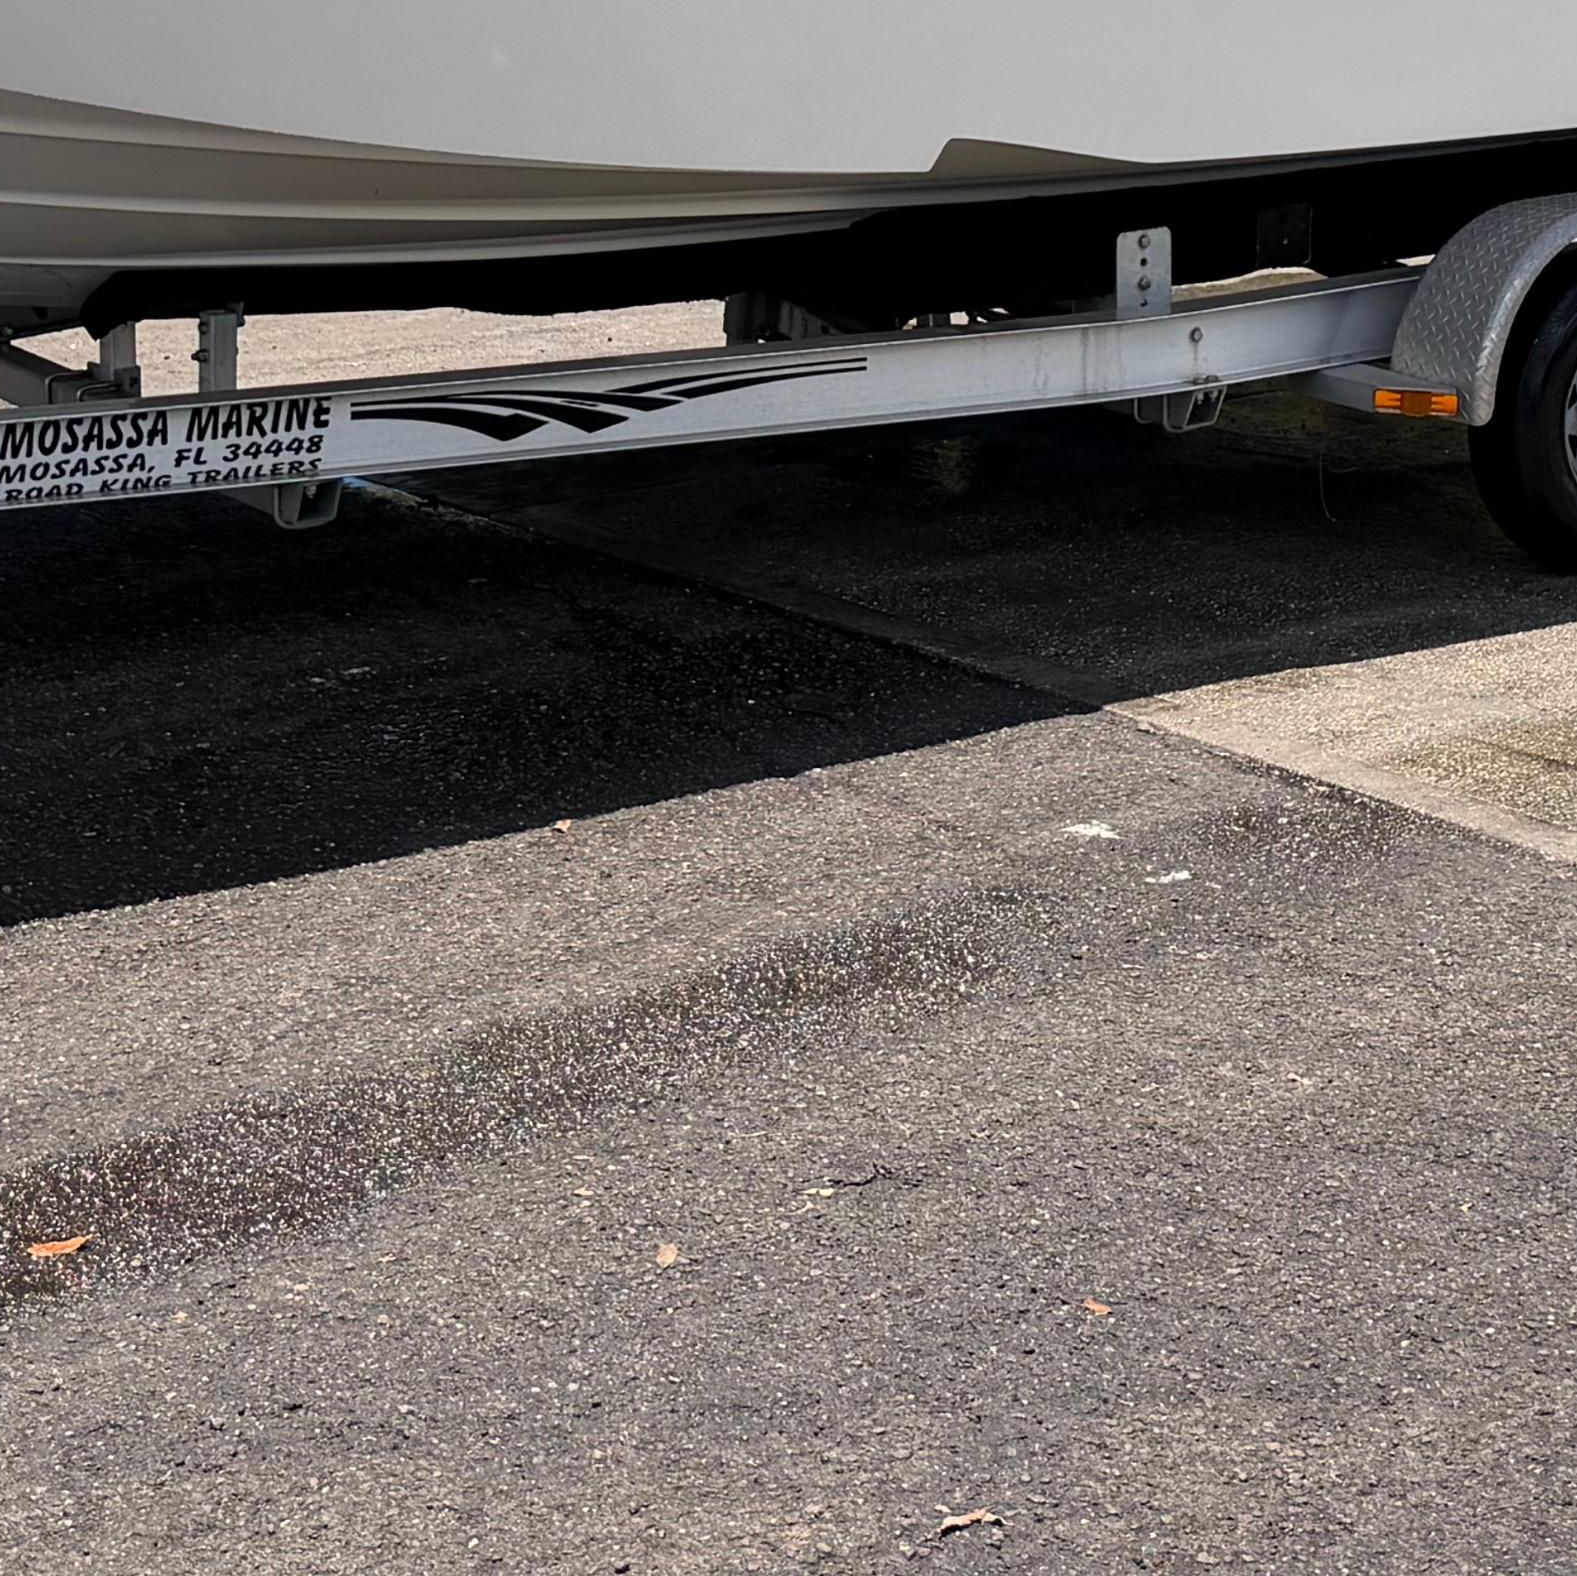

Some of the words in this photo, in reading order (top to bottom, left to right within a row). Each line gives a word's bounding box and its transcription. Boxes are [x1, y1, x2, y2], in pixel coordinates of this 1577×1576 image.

[185, 396, 332, 443] MARINE
[174, 446, 207, 468] FL
[222, 434, 324, 463] 34448
[5, 483, 84, 505] ROAD
[100, 474, 172, 494] KING
[187, 457, 322, 484] TRAILERS
